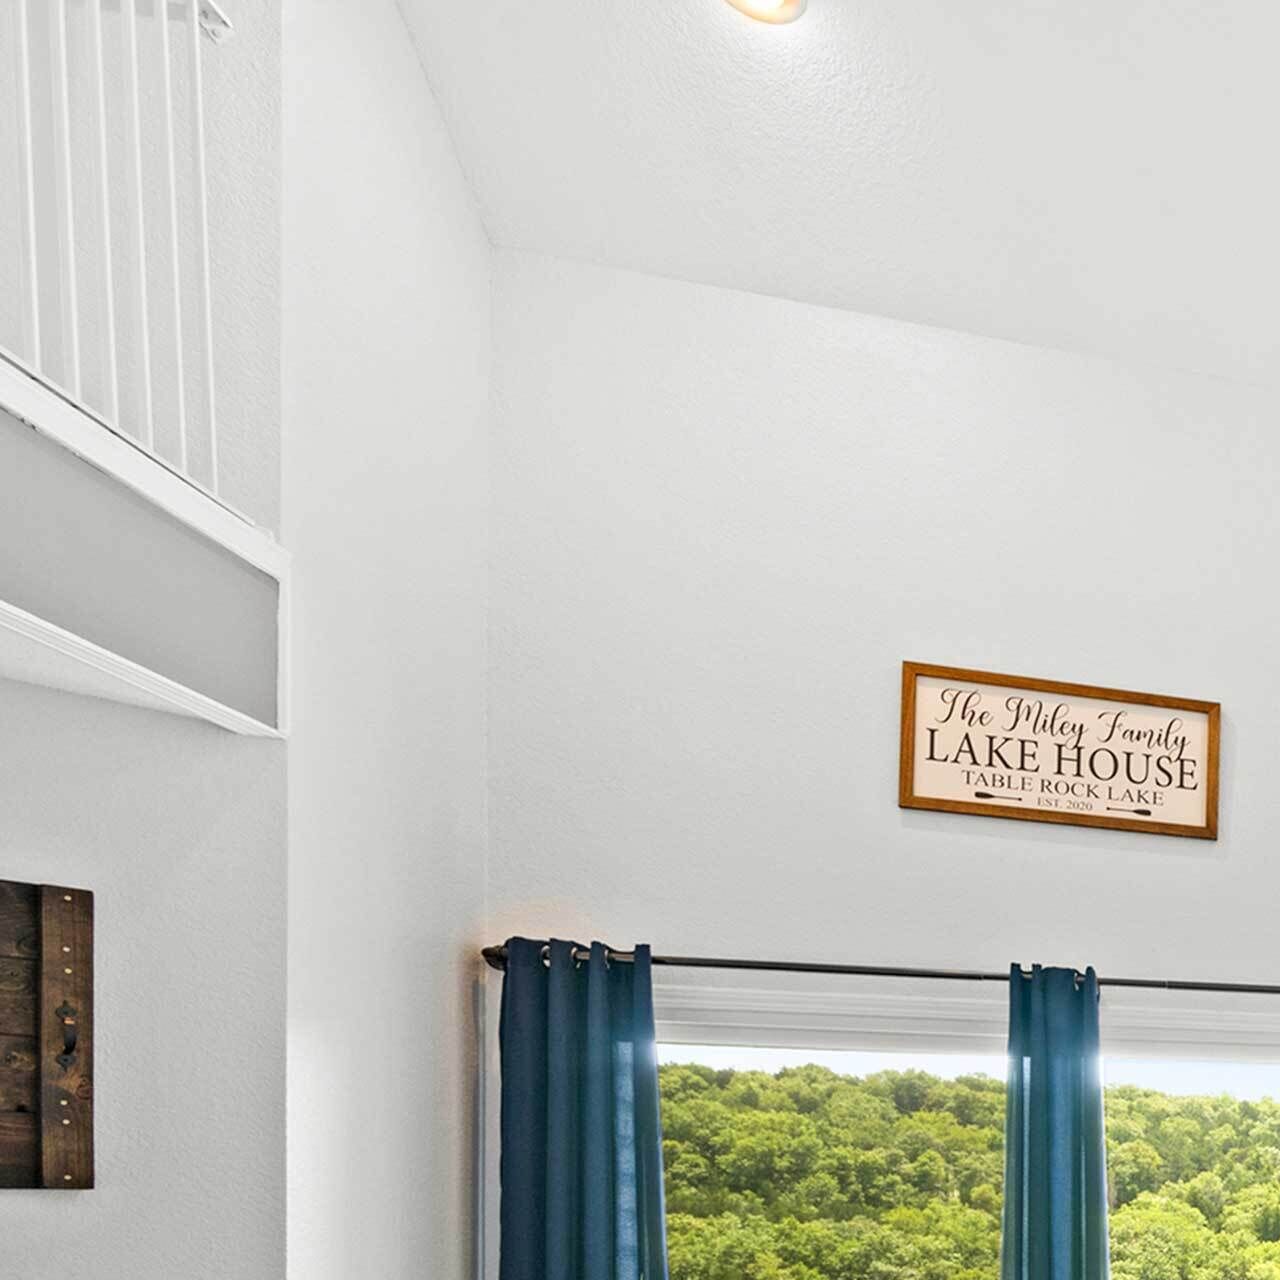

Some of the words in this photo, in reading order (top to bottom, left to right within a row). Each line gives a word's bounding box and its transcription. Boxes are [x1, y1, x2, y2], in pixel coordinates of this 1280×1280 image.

[935, 687, 994, 727] The
[1002, 695, 1089, 749] Miley
[1097, 709, 1192, 762] Family
[925, 728, 1041, 773] LAKE
[1053, 742, 1199, 790] HOUSE
[961, 769, 1033, 792] TABLE
[1040, 780, 1100, 799] ROCK
[1107, 786, 1165, 806] LAKE
[1066, 799, 1094, 811] 2020
